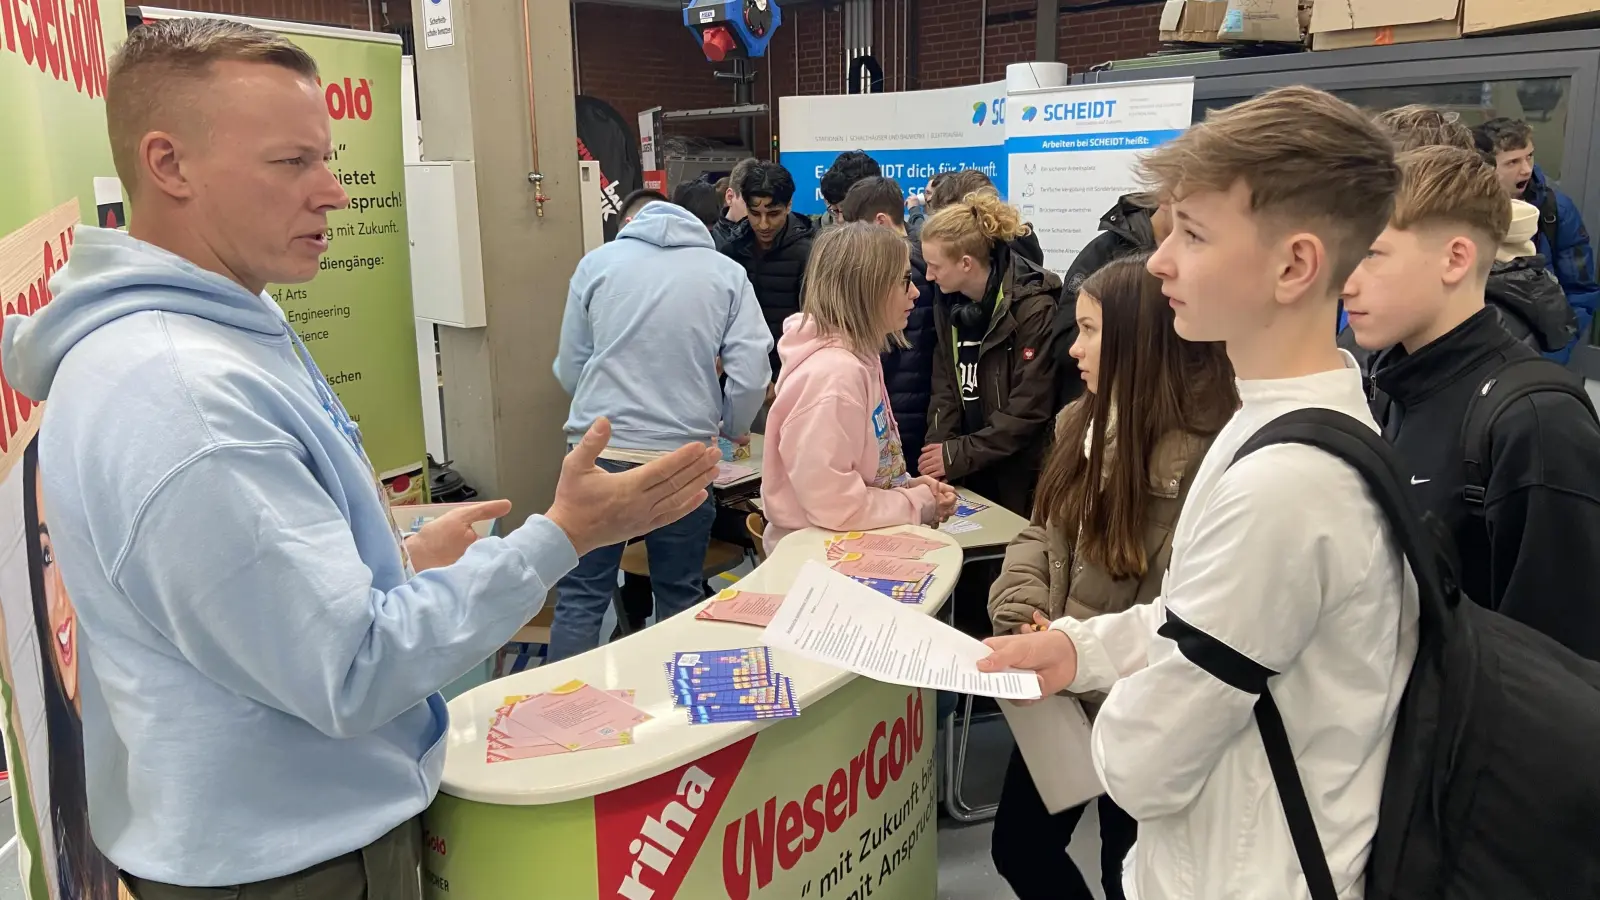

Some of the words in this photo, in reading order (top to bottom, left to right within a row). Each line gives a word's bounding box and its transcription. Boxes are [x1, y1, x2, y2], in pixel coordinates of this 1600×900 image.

[324, 77, 373, 120] old
[1044, 100, 1117, 121] SCHEIDT
[1042, 139, 1074, 149] Arbeiten
[1076, 139, 1088, 148] bei
[1090, 138, 1124, 147] SCHEIDT
[1125, 137, 1150, 146] heißt:
[333, 169, 376, 185] ietet
[907, 163, 934, 178] dich
[336, 223, 355, 236] mit
[357, 220, 399, 235] Zukunft.
[320, 255, 384, 271] diengänge:
[286, 288, 307, 300] Arts
[288, 305, 350, 324] Engineering
[326, 371, 361, 386] ischen
[722, 687, 924, 900] WeserGold
[617, 765, 716, 900] riha
[820, 849, 853, 898] mit
[859, 781, 919, 863] Zukunft
